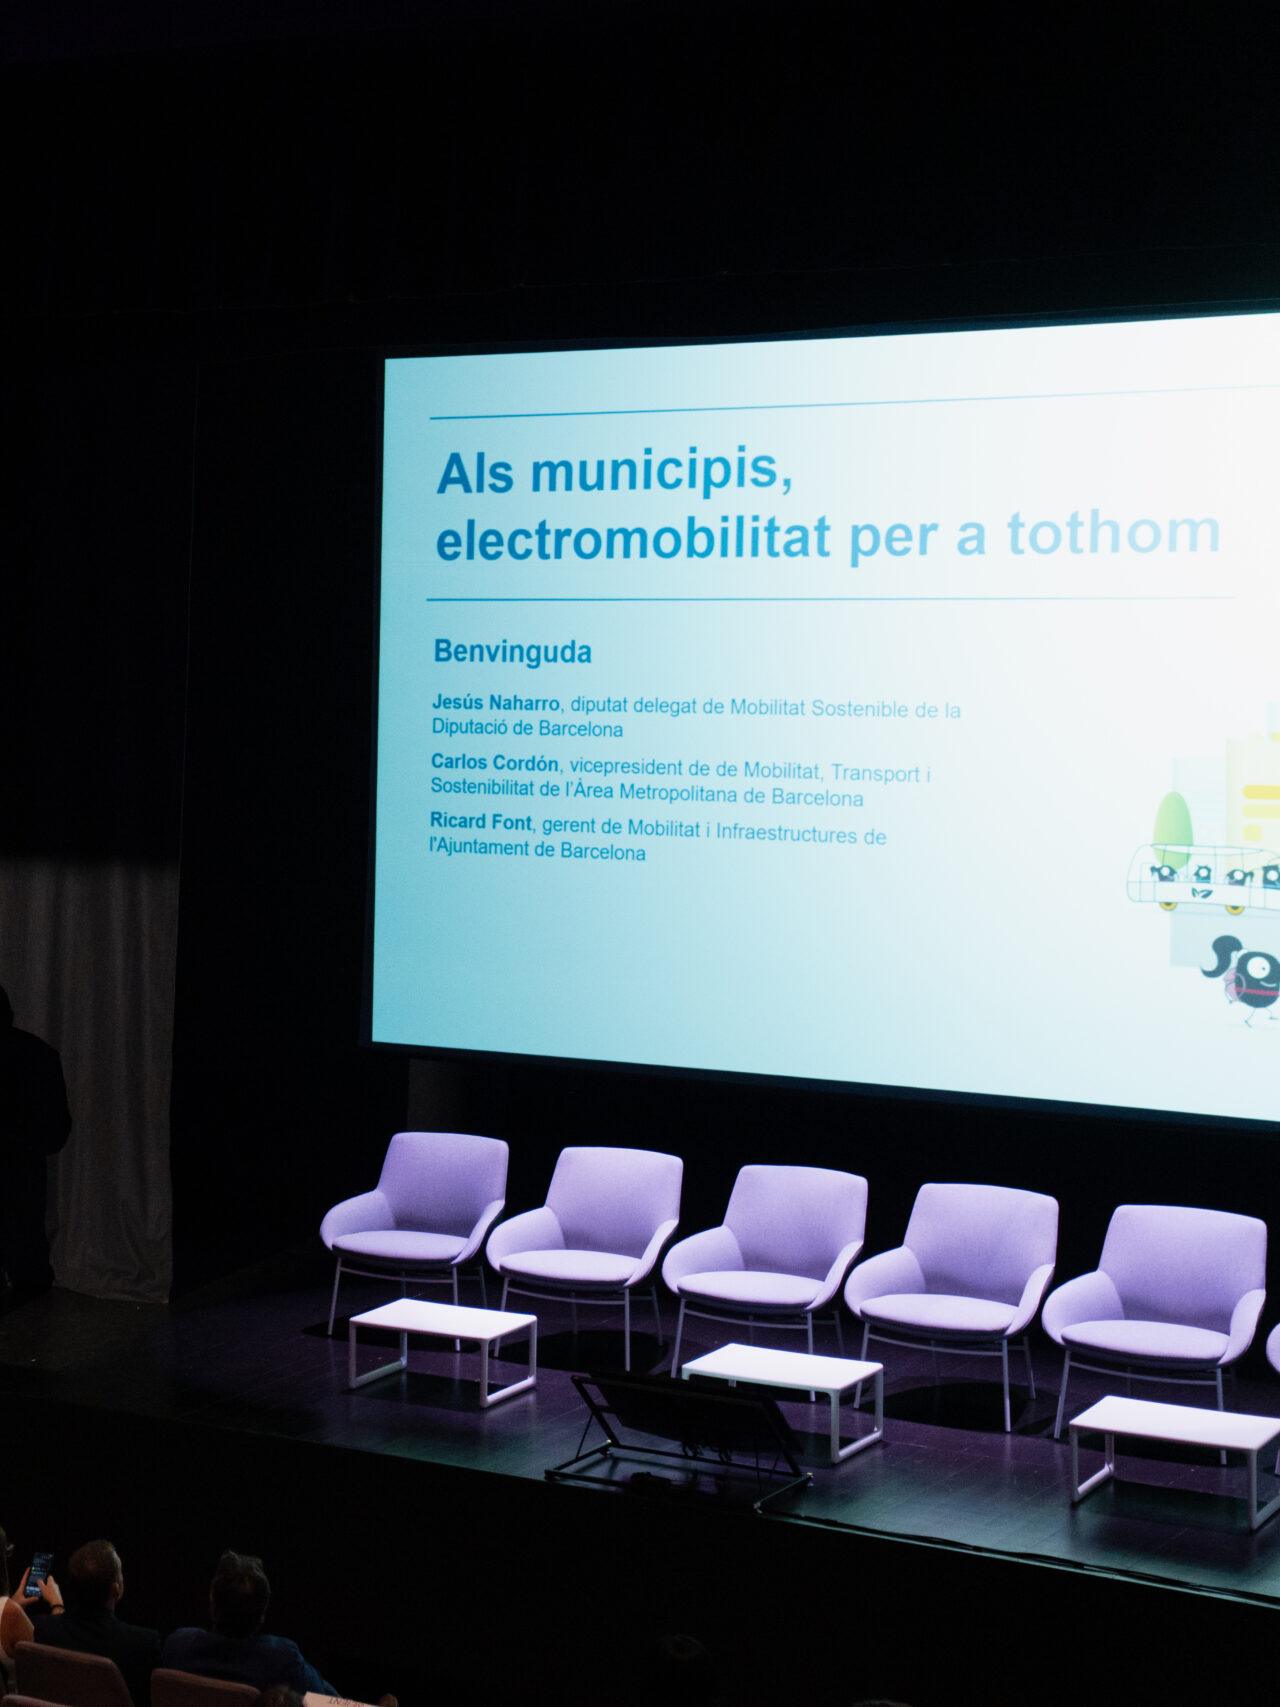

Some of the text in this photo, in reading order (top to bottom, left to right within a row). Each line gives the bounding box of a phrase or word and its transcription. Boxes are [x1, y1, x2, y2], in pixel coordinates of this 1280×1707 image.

[437, 445, 793, 500] Als municipis,
[437, 508, 1219, 568] electromobilitat per a tothom
[435, 638, 592, 669] Benvinguda
[432, 693, 961, 719] Jesús Naharro, diputat delegat de Mobilitat Sostenible de la
[432, 717, 623, 737] Diputació de Barcelona
[431, 753, 932, 785] Carlos Cordón, vicepresident de de Mobilitat, Transport i
[431, 777, 534, 796] Sostenibilitat
[539, 780, 561, 797] de
[619, 782, 737, 804] Metropolitana
[743, 787, 766, 804] de
[772, 787, 864, 807] Barcelona
[430, 811, 887, 845] Ricard Font, gerent de Mobilitat i Infraestructures de
[534, 841, 555, 857] de
[561, 841, 646, 862] Barcelona
